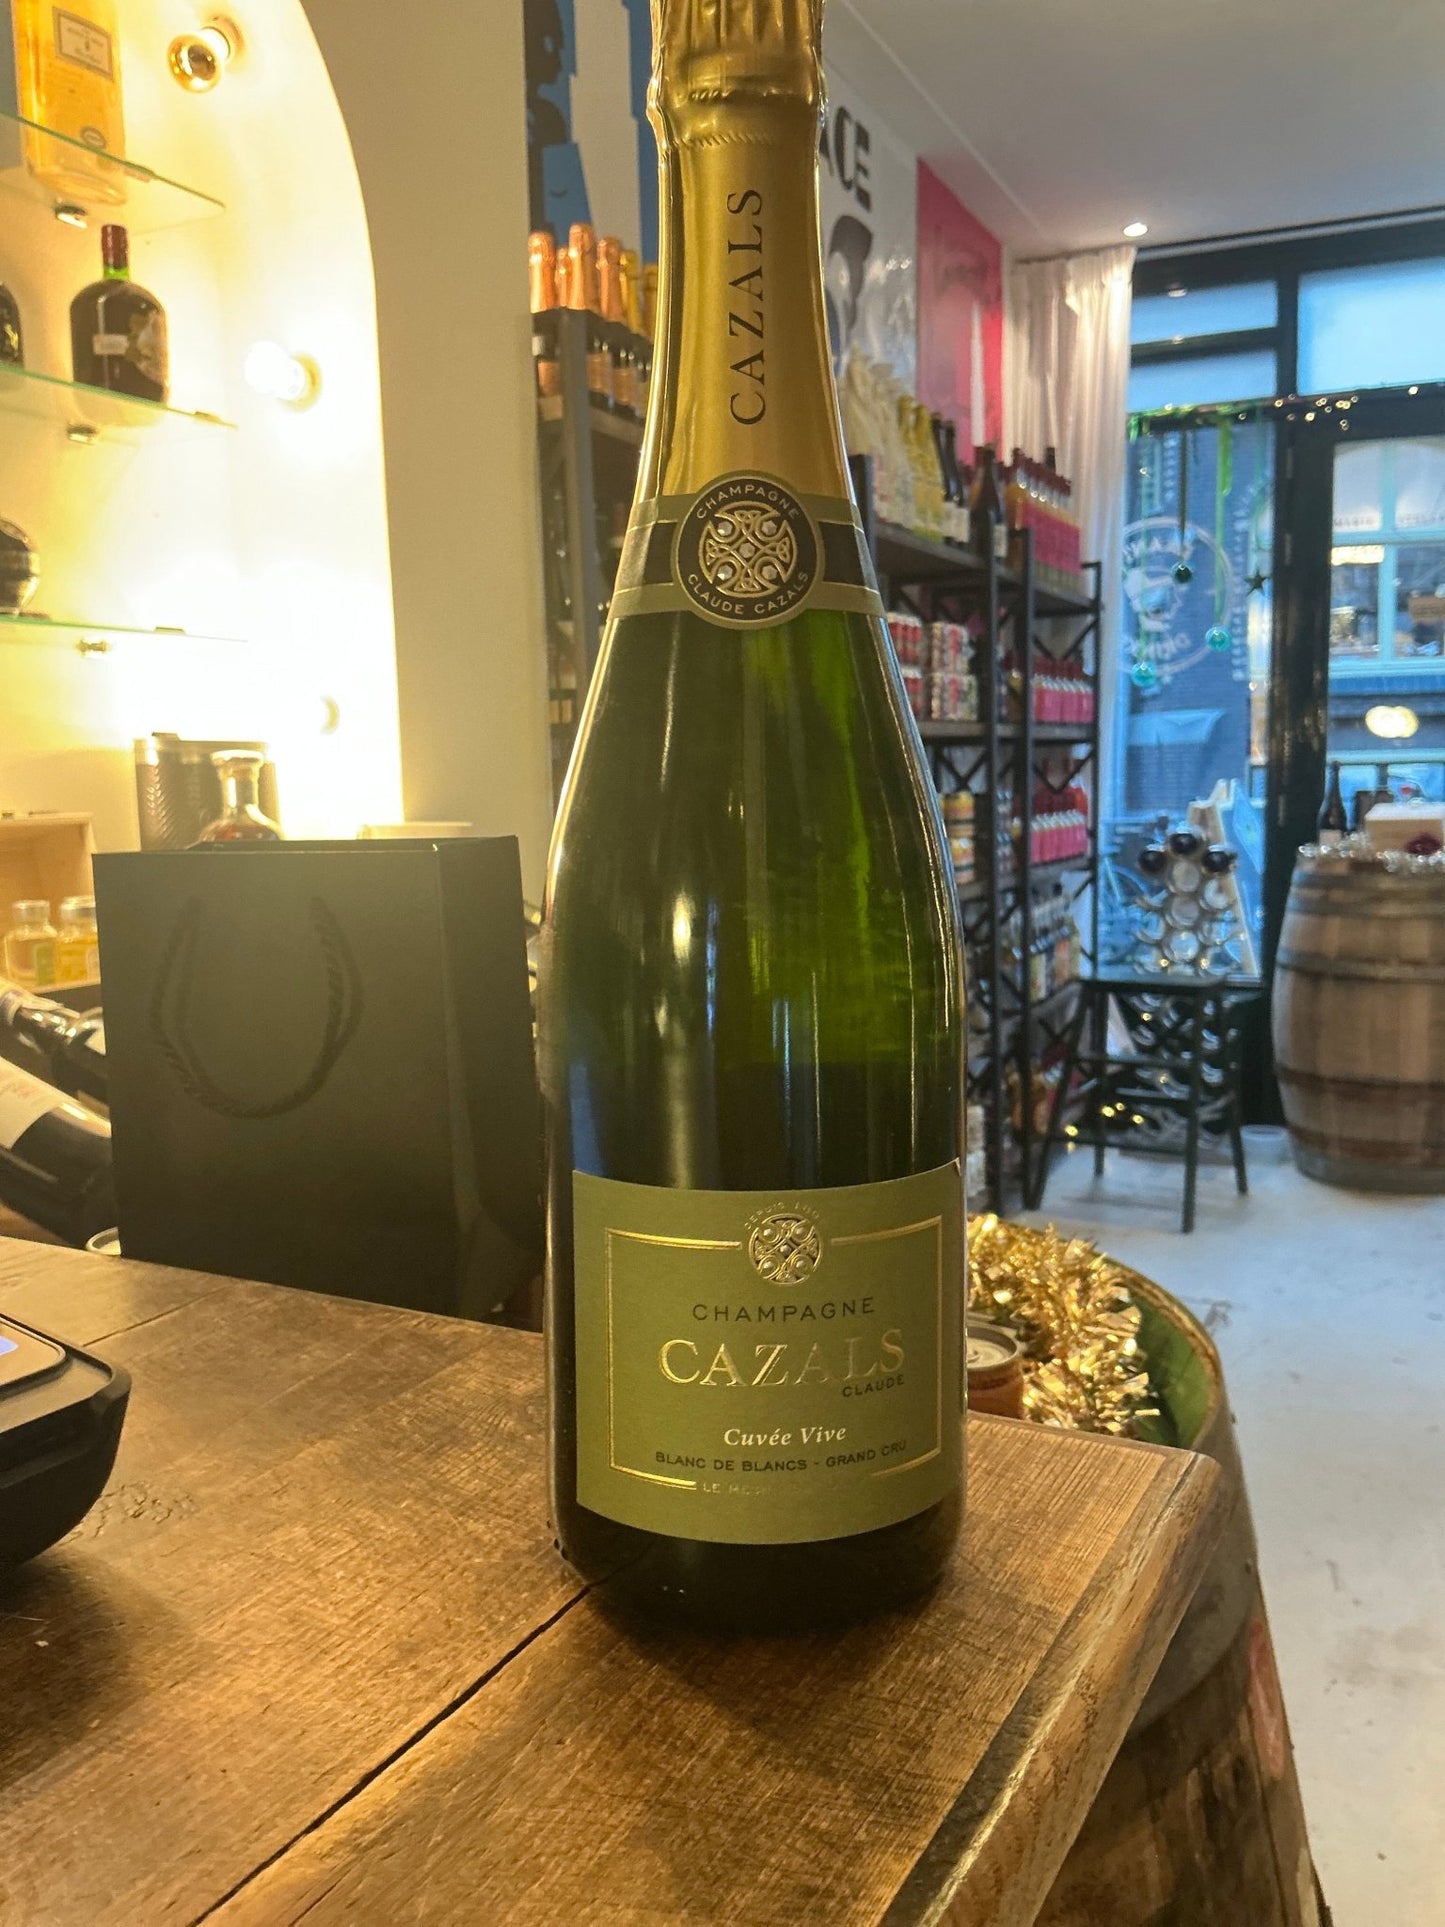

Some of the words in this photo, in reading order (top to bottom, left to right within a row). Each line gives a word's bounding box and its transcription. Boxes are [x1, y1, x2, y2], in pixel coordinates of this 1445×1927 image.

[727, 189, 766, 425] CAZALS
[696, 484, 799, 519] CHAMPAGNE
[688, 573, 744, 614] CLAUDE
[754, 571, 808, 614] CAZALS
[693, 1296, 875, 1322] CHAMPAGNE
[659, 1328, 905, 1387] CAZALS
[842, 1374, 904, 1398] CLAUDE
[724, 1427, 792, 1446] Cuvée
[800, 1426, 847, 1444] Vive
[656, 1452, 706, 1469] BLANC
[713, 1459, 735, 1471] DE
[742, 1459, 808, 1472] BLANCS
[826, 1450, 876, 1468] GRAND
[881, 1440, 907, 1456] CRU
